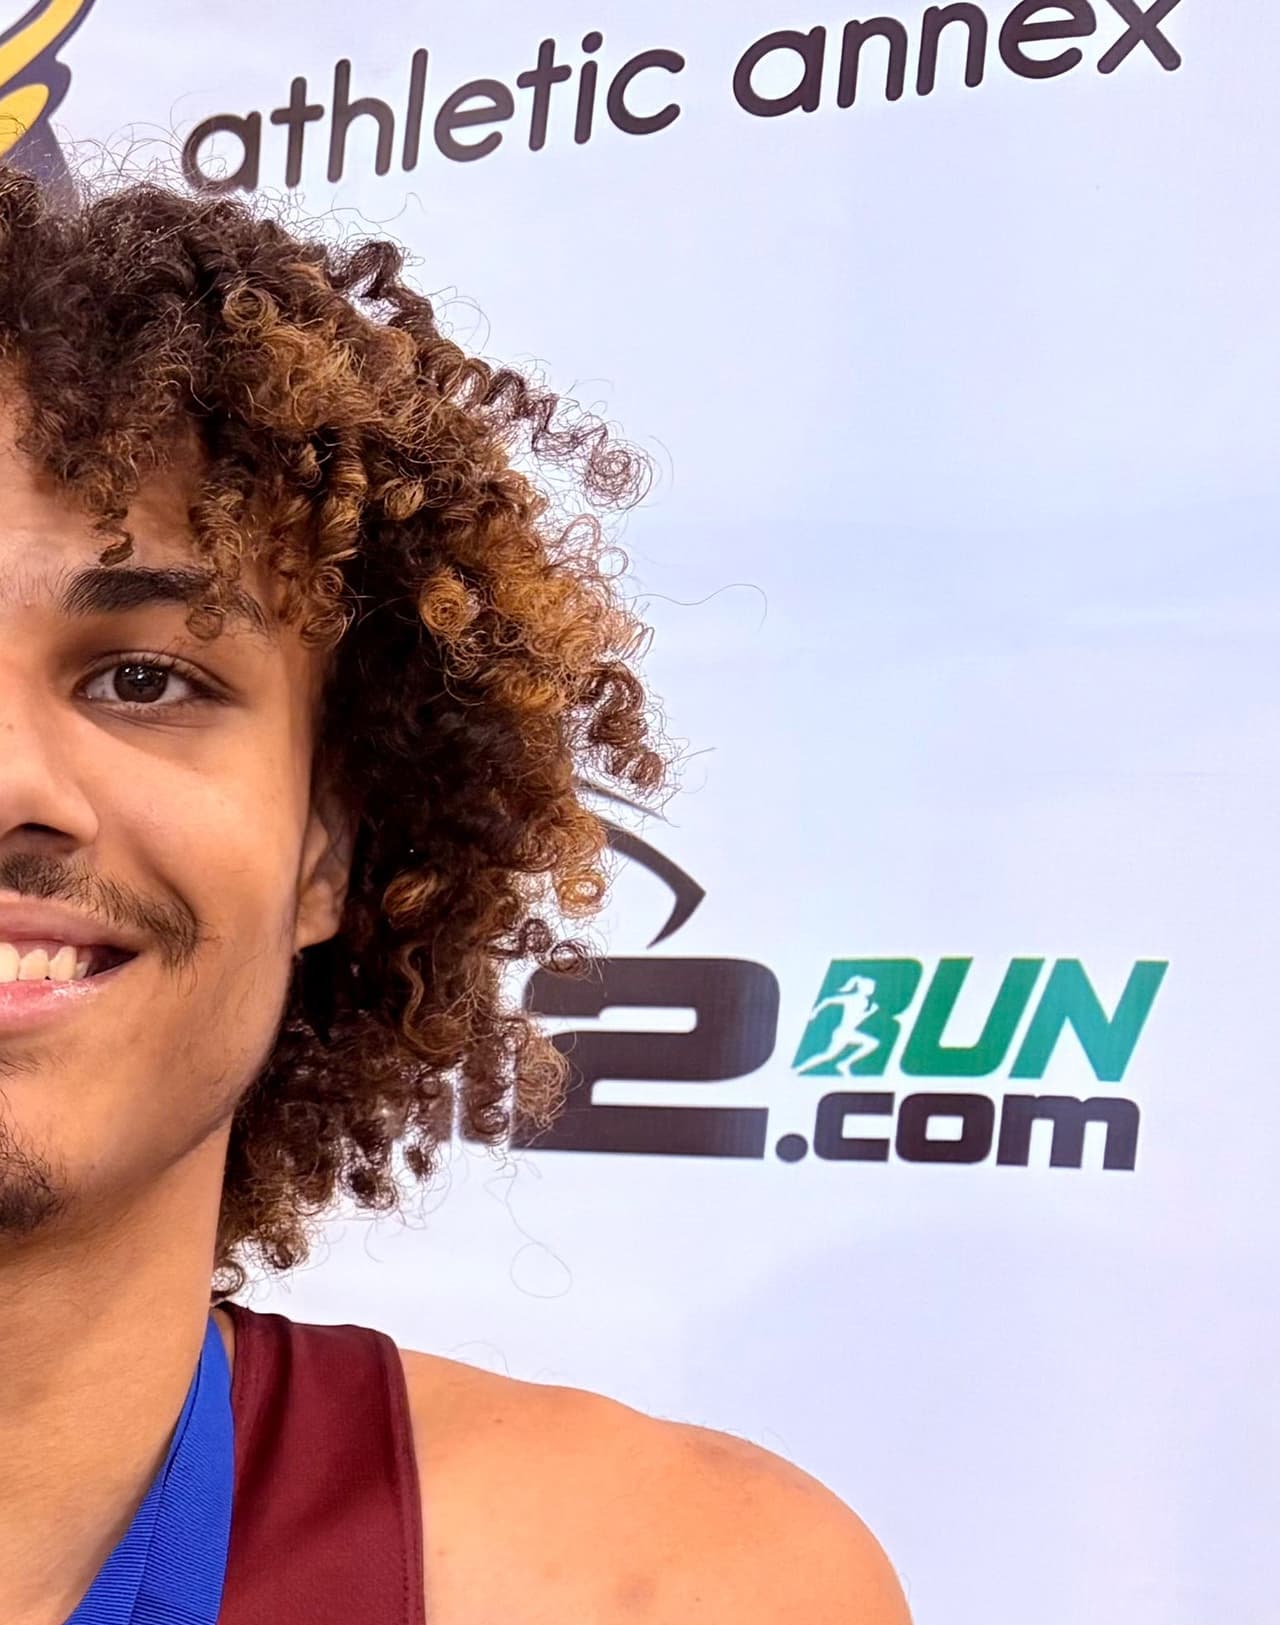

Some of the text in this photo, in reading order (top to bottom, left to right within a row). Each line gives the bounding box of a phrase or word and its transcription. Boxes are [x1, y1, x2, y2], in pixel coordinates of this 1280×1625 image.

[180, 0, 1182, 194] athletic annex
[791, 957, 1169, 1082] RUN
[775, 1091, 1140, 1171] .com
